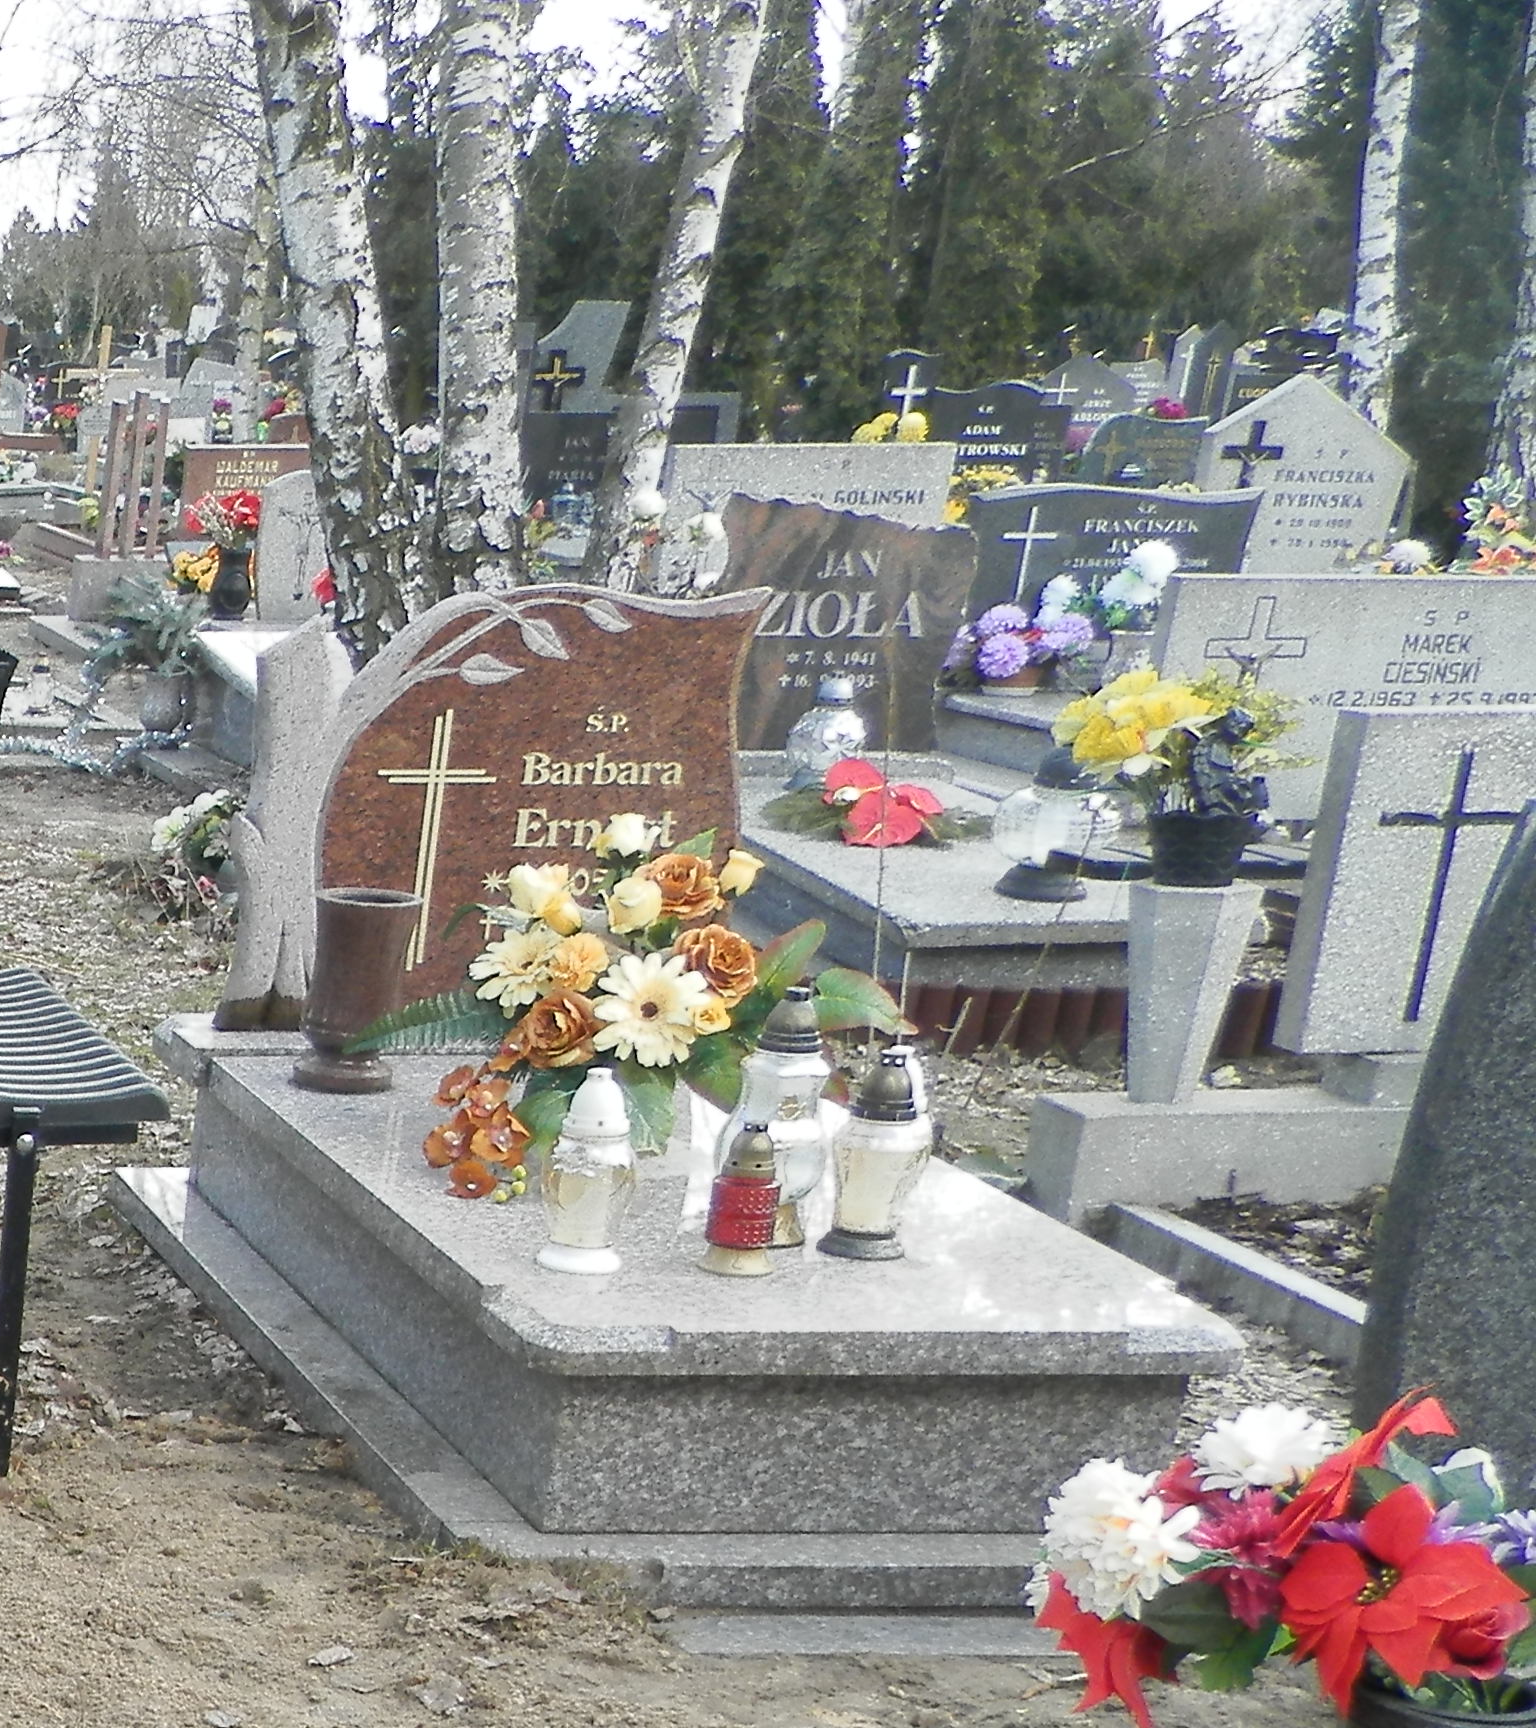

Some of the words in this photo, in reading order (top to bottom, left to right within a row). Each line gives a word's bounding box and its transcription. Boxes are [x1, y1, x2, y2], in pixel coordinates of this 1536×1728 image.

[962, 424, 1003, 436] ADAM
[216, 460, 279, 474] WALDEMAR
[1273, 468, 1375, 483] FRANCISZKA
[1083, 518, 1200, 533] FRANCISZEK
[816, 550, 883, 580] JAN
[754, 590, 925, 639] ZIOŁA
[1401, 633, 1473, 654] MAREK
[585, 705, 630, 733] Ś.P.
[520, 751, 684, 786] Barbara
[511, 807, 678, 851] Ernt
